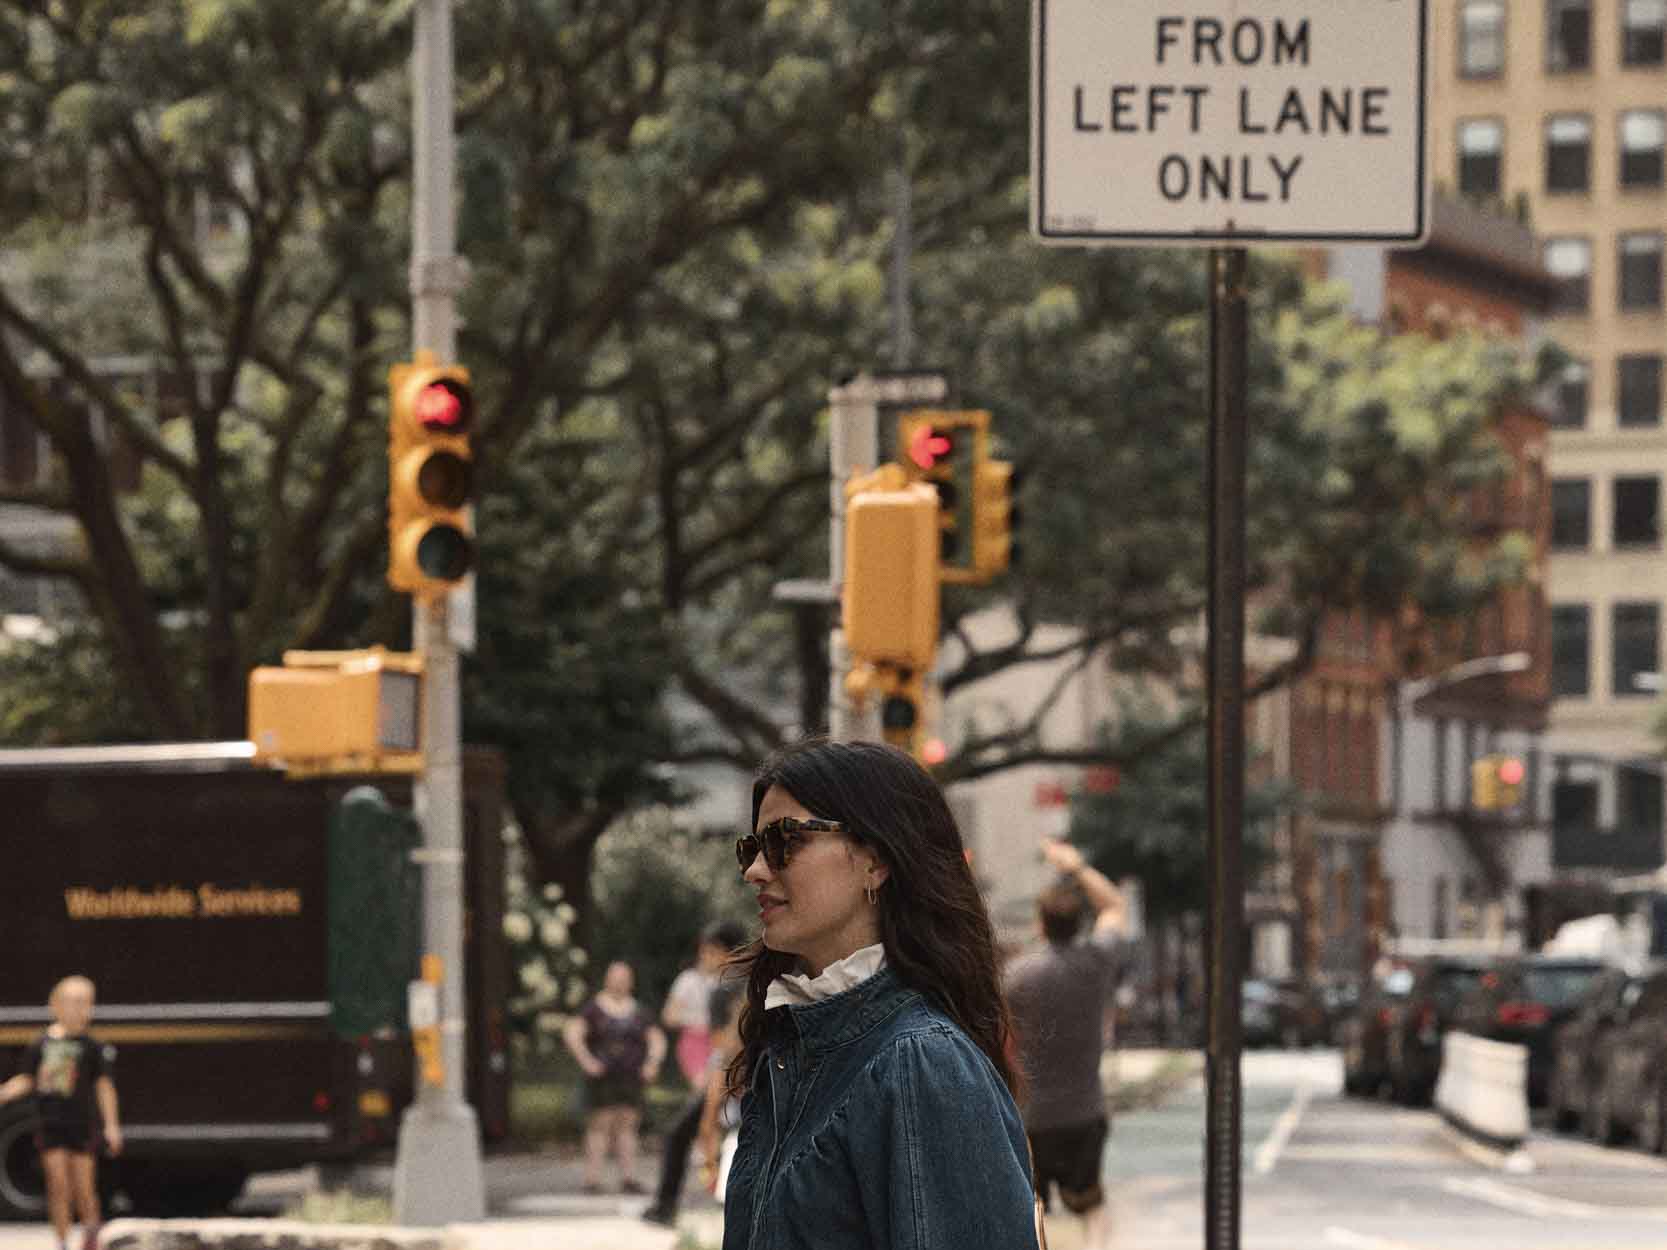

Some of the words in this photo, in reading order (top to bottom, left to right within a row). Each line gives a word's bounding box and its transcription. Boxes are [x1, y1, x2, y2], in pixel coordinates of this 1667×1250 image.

[1155, 16, 1311, 66] FROM
[1073, 84, 1209, 134] LEFT
[1238, 86, 1390, 136] LANE
[1157, 153, 1303, 202] ONLY
